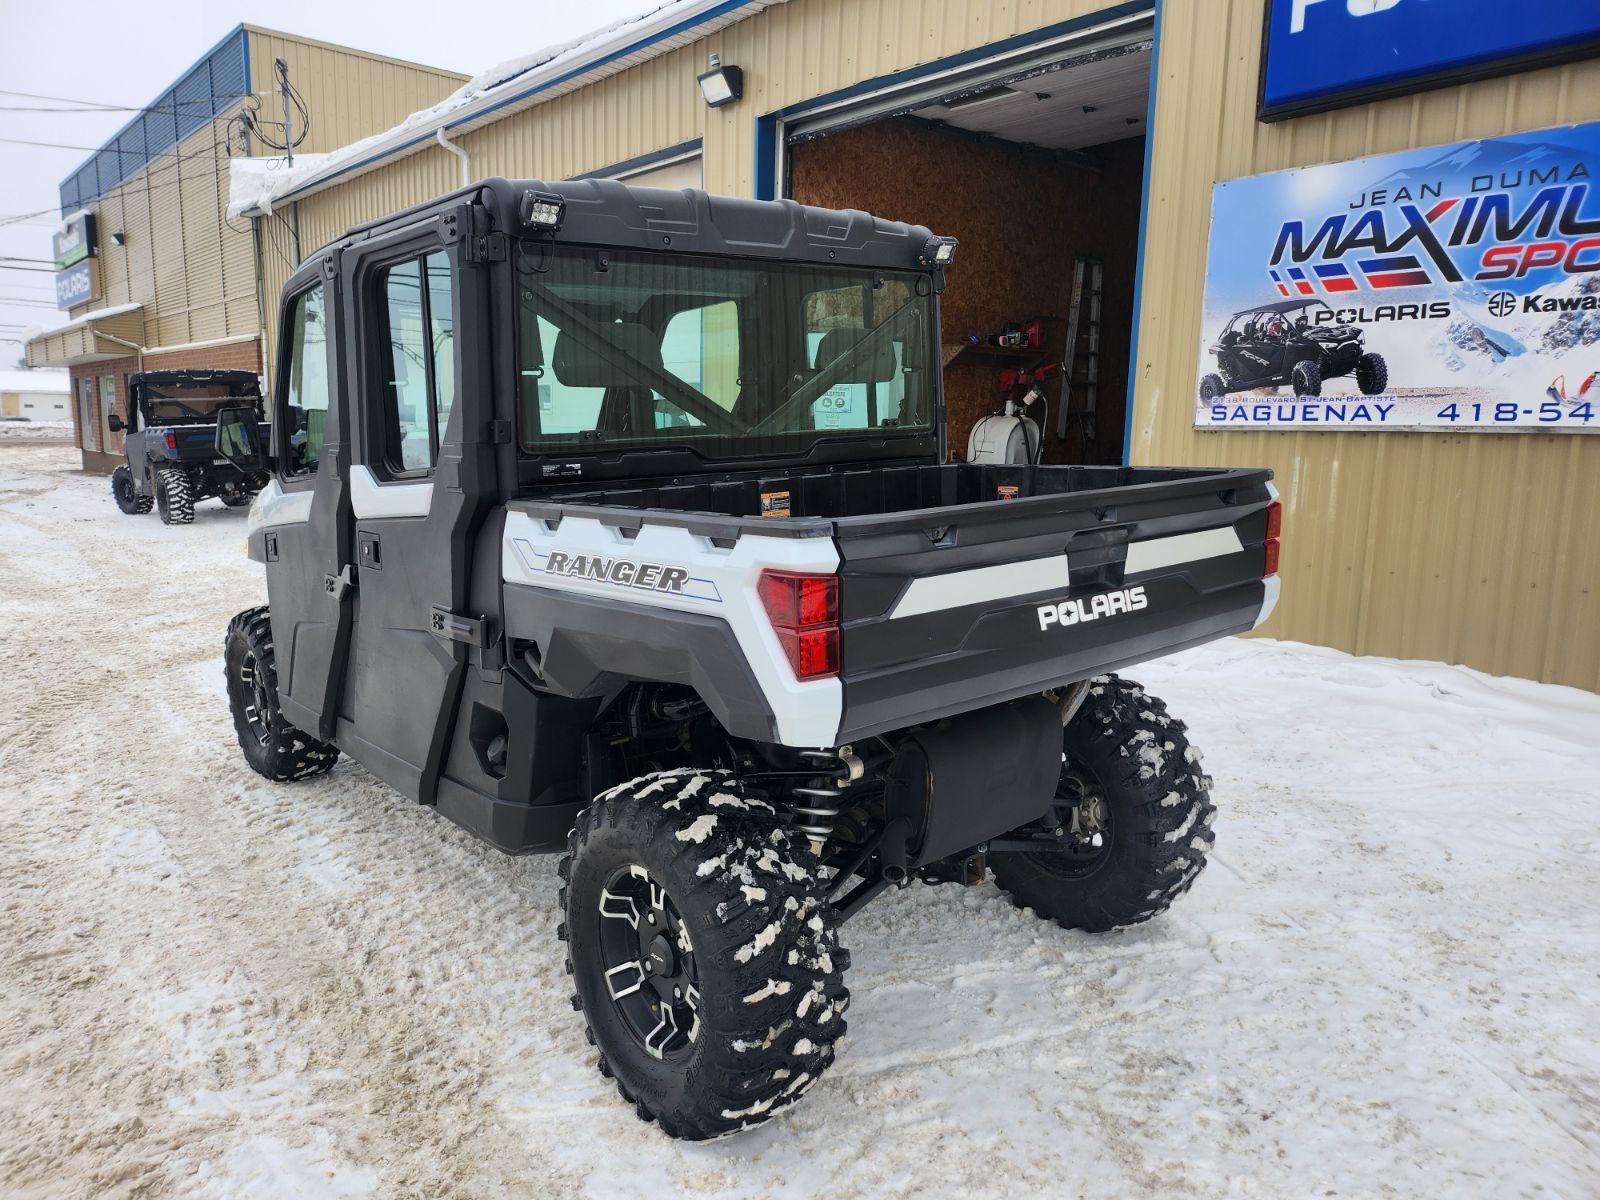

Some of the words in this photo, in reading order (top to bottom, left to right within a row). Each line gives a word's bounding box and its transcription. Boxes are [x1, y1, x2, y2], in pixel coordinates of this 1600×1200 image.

[1349, 181, 1442, 209] JEAN
[1471, 162, 1591, 193] DUMA
[1315, 301, 1451, 326] POLARIS
[1523, 294, 1600, 314] Kawa
[1211, 404, 1395, 422] SAGUENAY
[546, 551, 689, 594] RANGER
[1037, 586, 1148, 632] POLARIS
